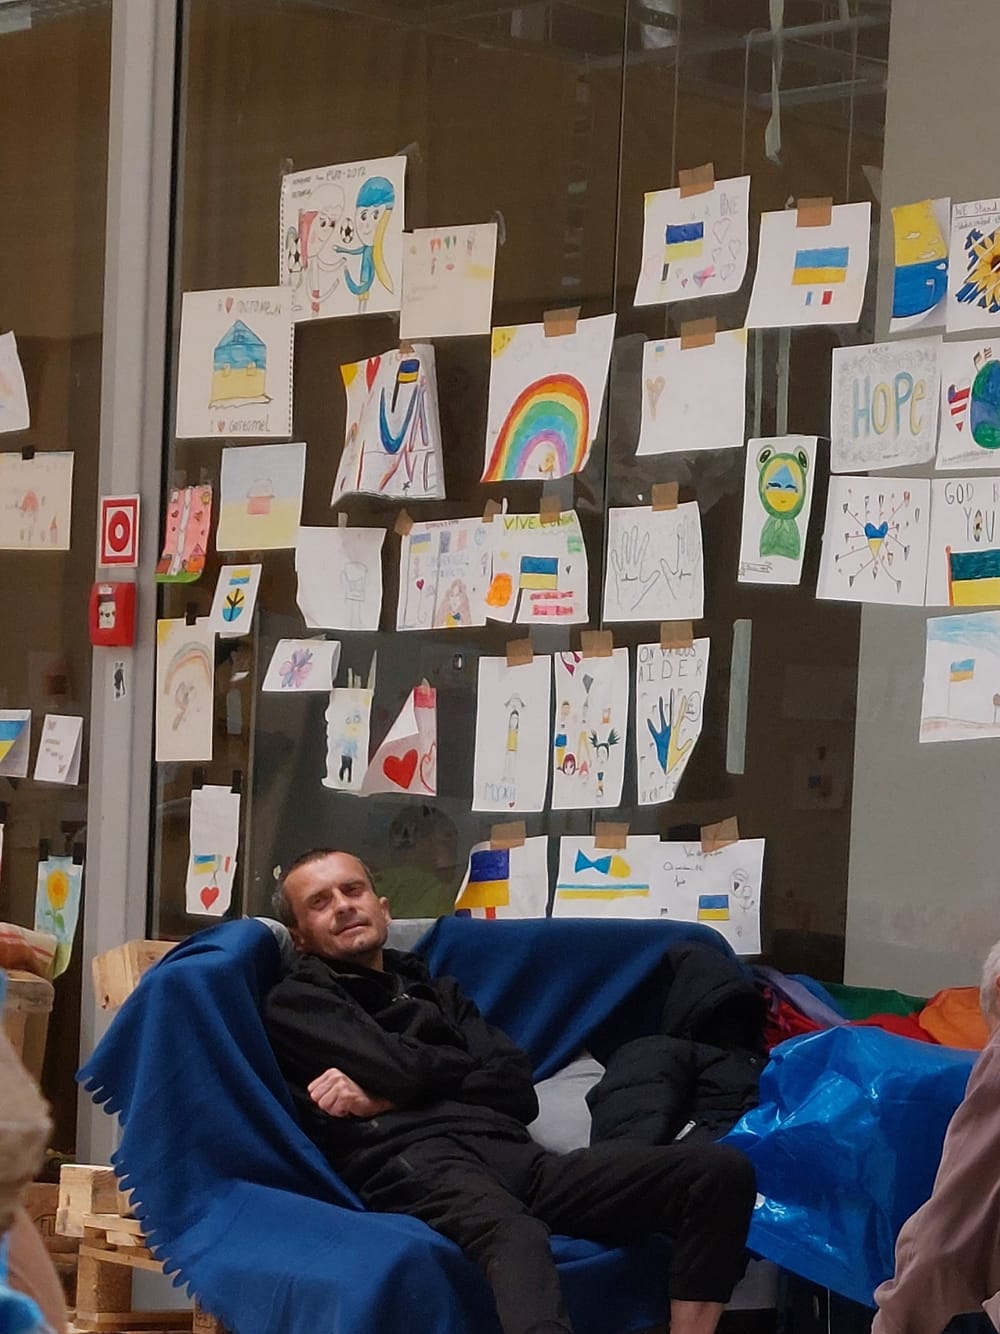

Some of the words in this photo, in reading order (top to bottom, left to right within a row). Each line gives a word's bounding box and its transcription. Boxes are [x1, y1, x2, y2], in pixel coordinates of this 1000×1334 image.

[944, 481, 975, 505] GOD
[963, 507, 996, 543] YOU
[639, 646, 654, 663] ON
[638, 658, 704, 683] AIDER
